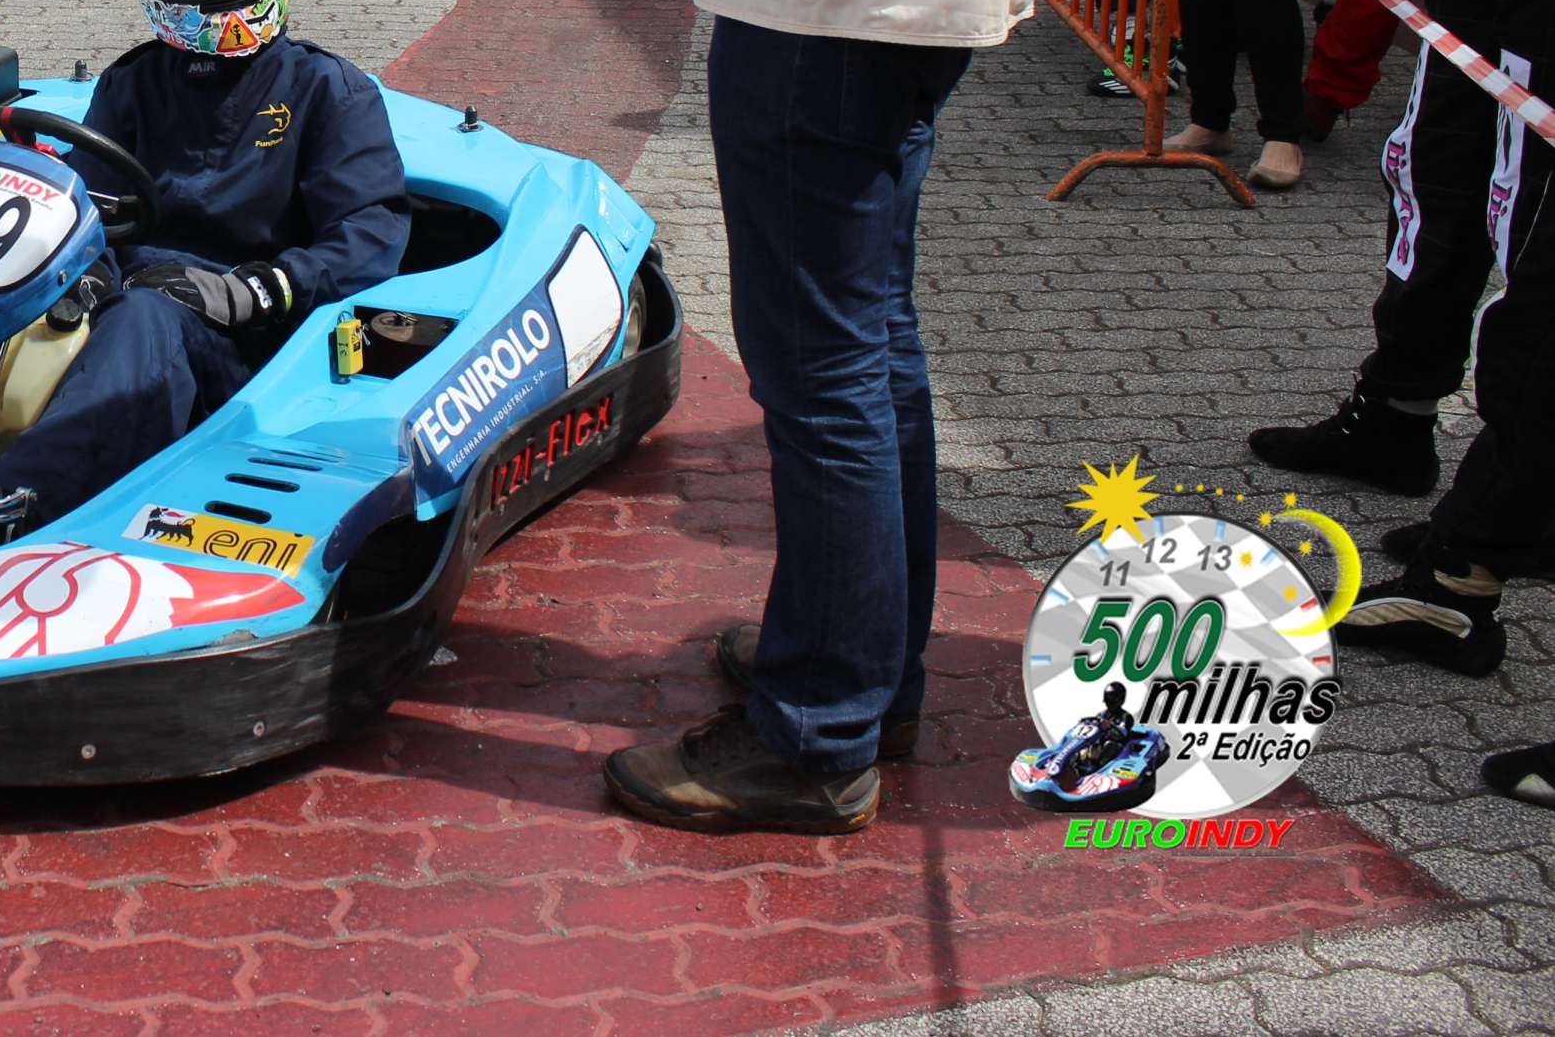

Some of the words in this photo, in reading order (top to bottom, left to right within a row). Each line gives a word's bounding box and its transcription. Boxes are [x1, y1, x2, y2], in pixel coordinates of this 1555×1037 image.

[411, 309, 550, 467] TECNIROLO
[446, 424, 491, 473] ENGENHARIA
[203, 529, 304, 572] eni
